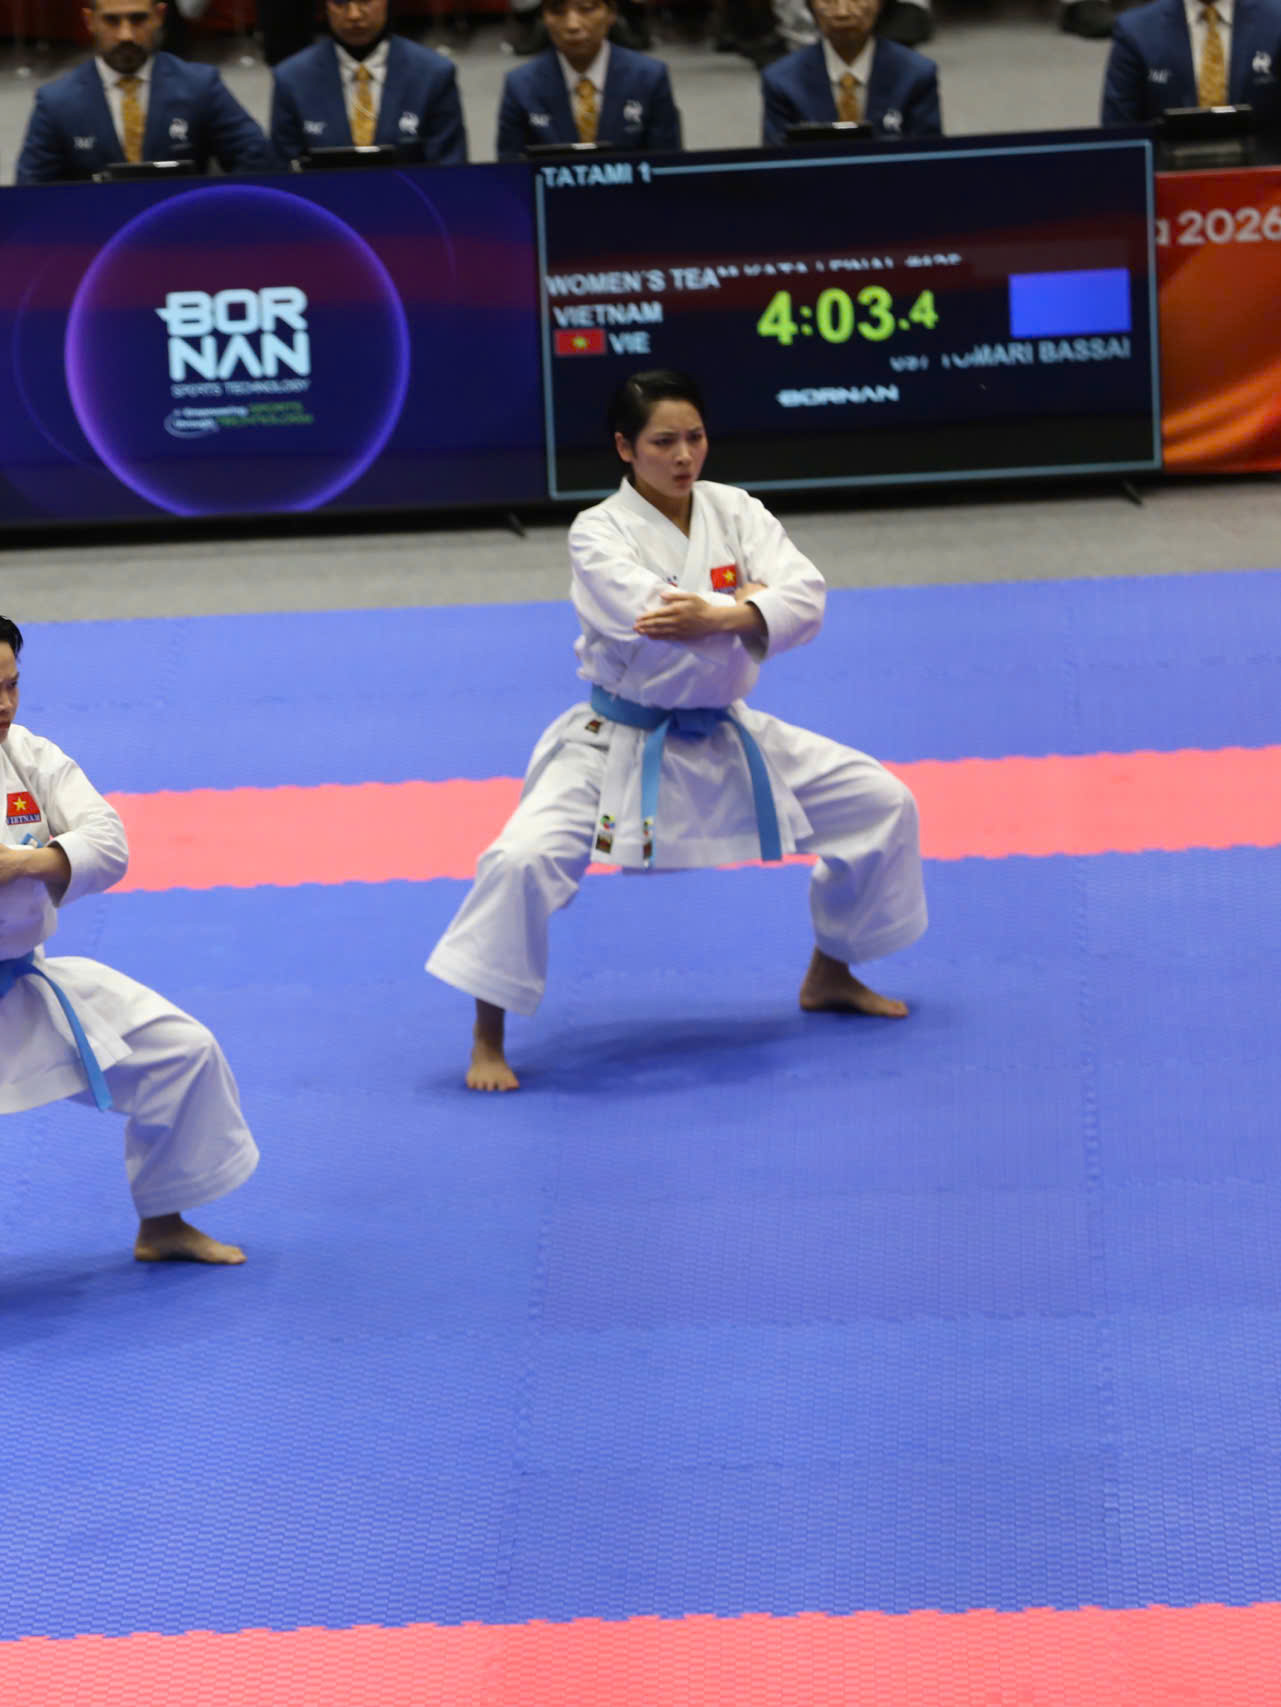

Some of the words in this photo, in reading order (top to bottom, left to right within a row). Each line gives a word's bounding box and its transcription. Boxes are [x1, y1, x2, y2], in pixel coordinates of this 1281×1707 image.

[540, 162, 634, 188] TATAMI
[637, 161, 652, 184] 1
[1177, 205, 1281, 247] 2026
[545, 269, 666, 297] WOMEN'S
[155, 286, 308, 337] BOR
[552, 300, 665, 328] VIETNAM
[756, 285, 940, 345] 4:03.4
[168, 329, 312, 383] NAN
[608, 330, 652, 356] VIE
[1038, 336, 1132, 364] BASSAI
[775, 383, 901, 408] BORNAN
